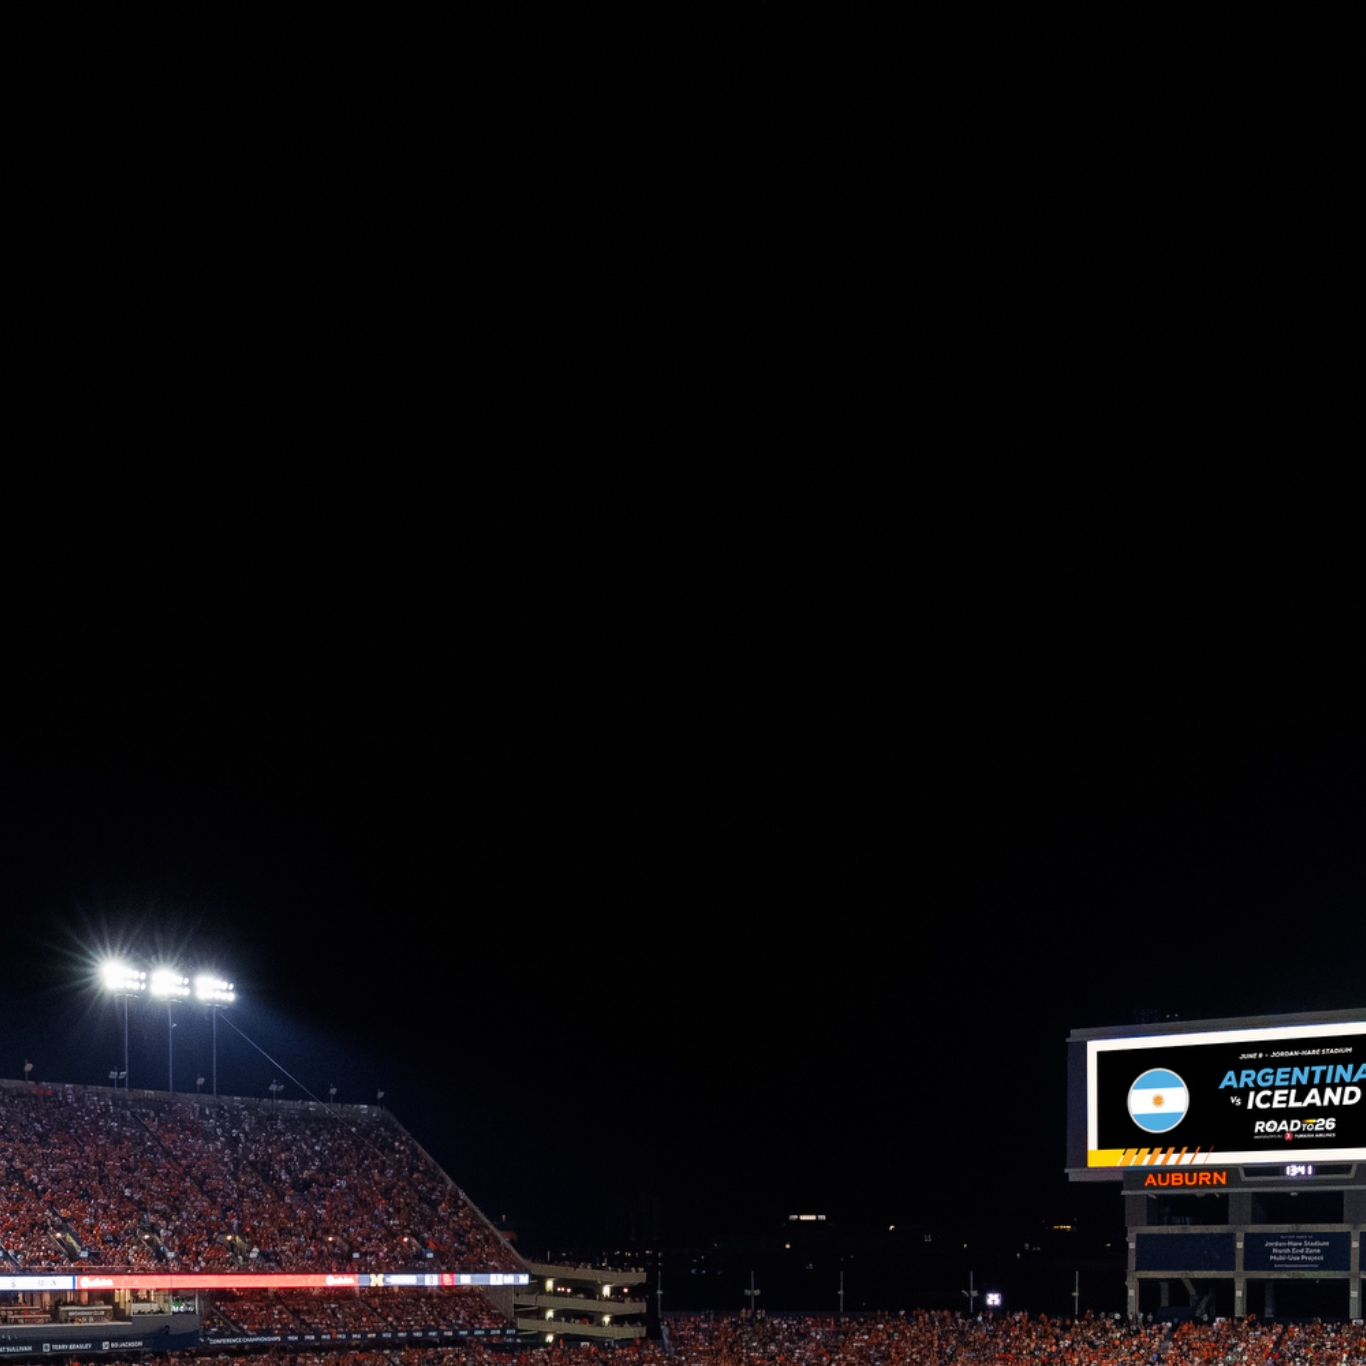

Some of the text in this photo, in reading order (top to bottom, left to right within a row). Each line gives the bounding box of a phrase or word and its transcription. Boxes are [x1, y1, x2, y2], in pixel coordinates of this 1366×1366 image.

[1239, 1052, 1257, 1060] JUNE
[1270, 1048, 1321, 1058] JORDAN-HARE
[1321, 1046, 1353, 1055] STADIUM
[1247, 1086, 1362, 1110] ICELAND
[1254, 1117, 1337, 1133] ROAD TO 26
[1144, 1171, 1227, 1187] AUBURN
